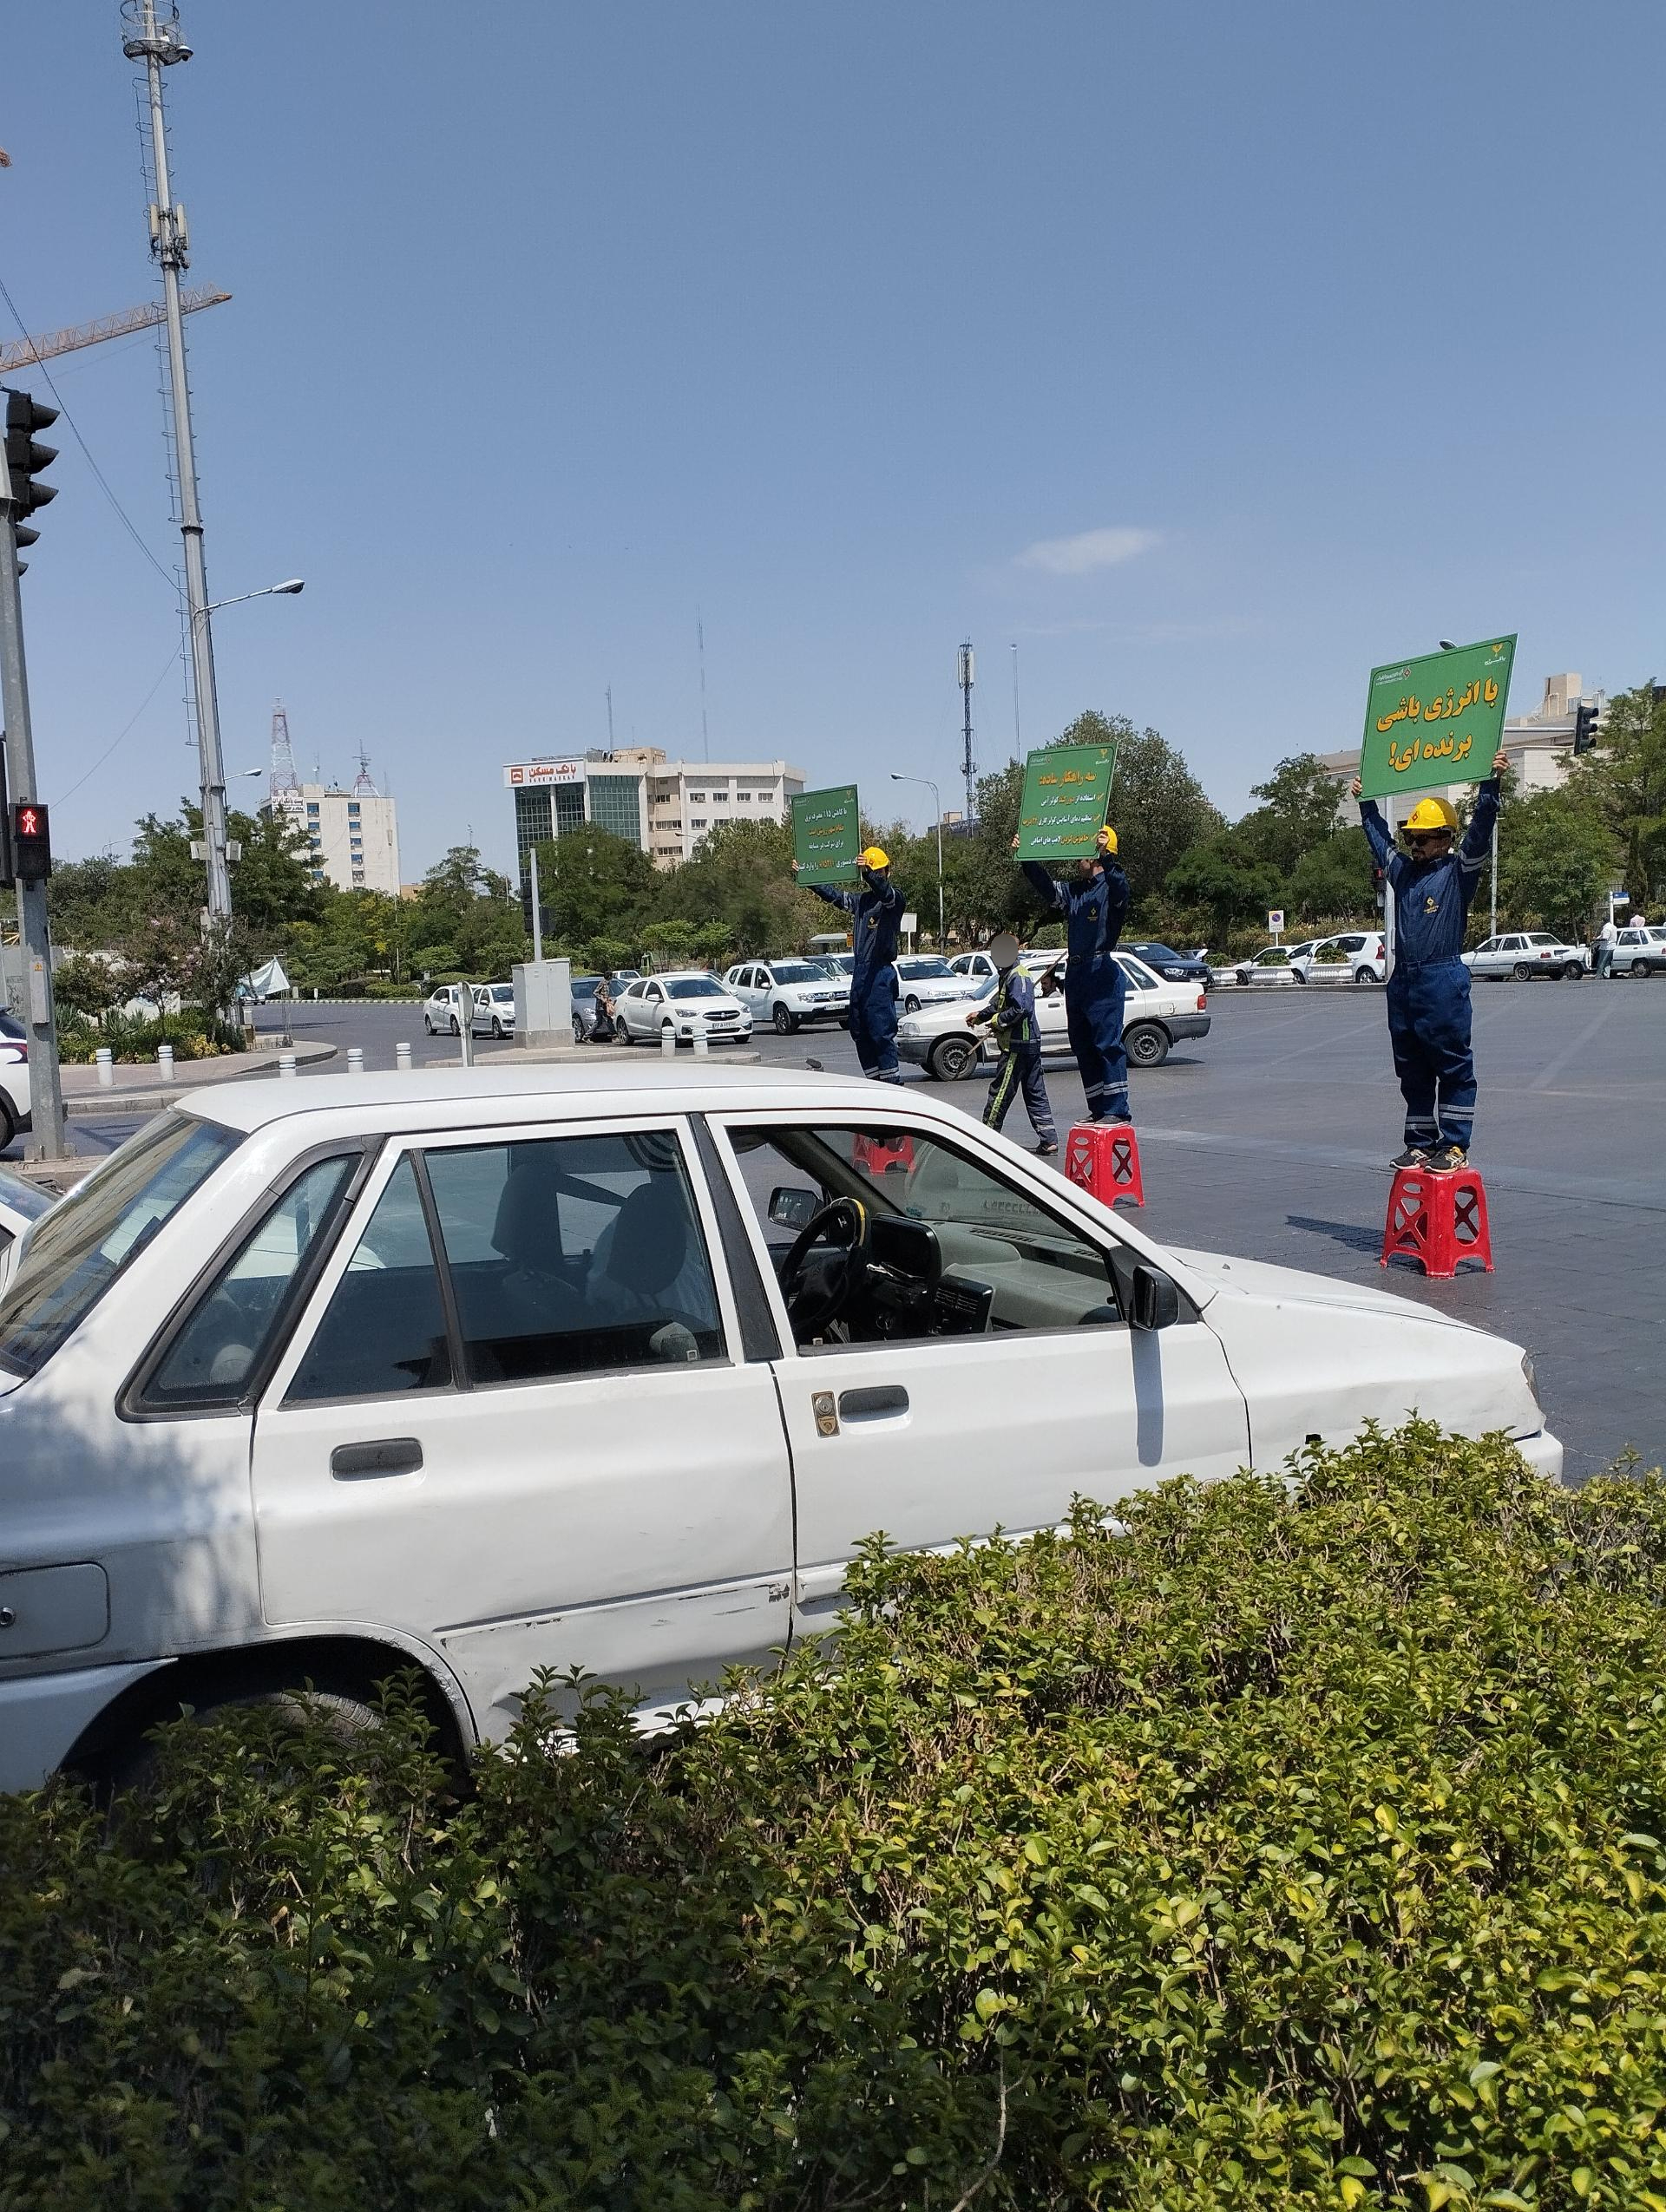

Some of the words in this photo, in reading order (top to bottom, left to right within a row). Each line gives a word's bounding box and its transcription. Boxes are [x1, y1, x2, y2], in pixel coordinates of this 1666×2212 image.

[1424, 679, 1480, 721] انرژی
[1484, 676, 1499, 708] با
[1376, 694, 1421, 732] باشی
[1388, 736, 1421, 772] ای!
[1423, 730, 1473, 762] برنده
[529, 766, 554, 777] مسکن
[556, 763, 576, 776] بانک
